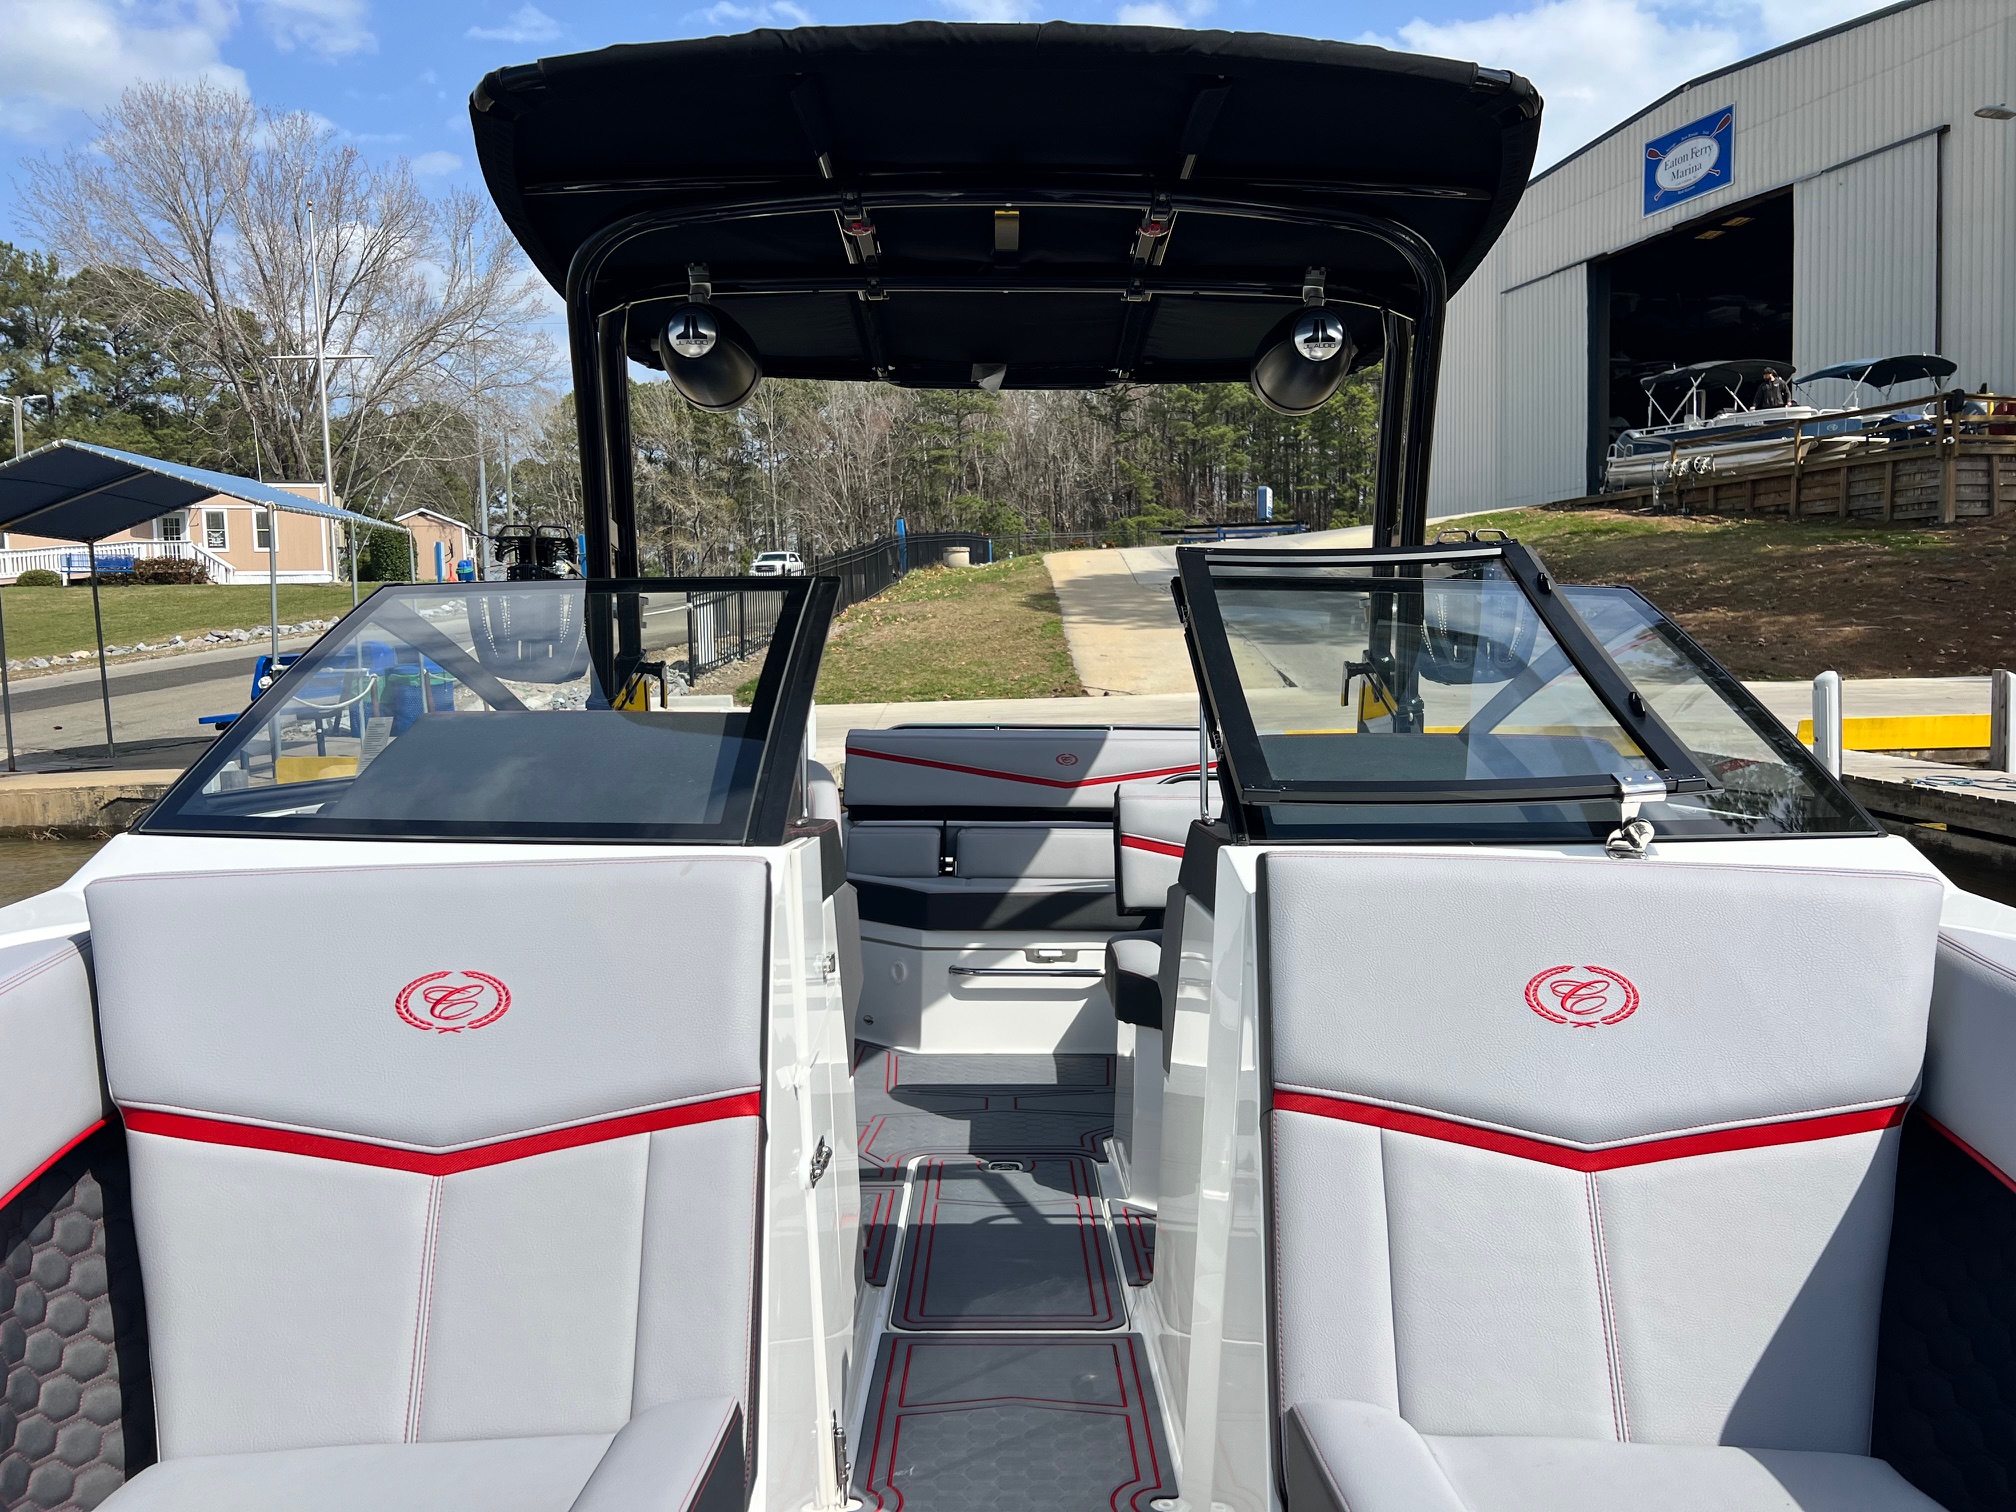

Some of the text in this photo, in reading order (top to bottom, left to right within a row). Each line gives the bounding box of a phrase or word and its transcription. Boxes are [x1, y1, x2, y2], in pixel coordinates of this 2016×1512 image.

[1664, 153, 1689, 171] Eaton
[1690, 145, 1713, 159] Ferry
[1671, 163, 1702, 181] Marina
